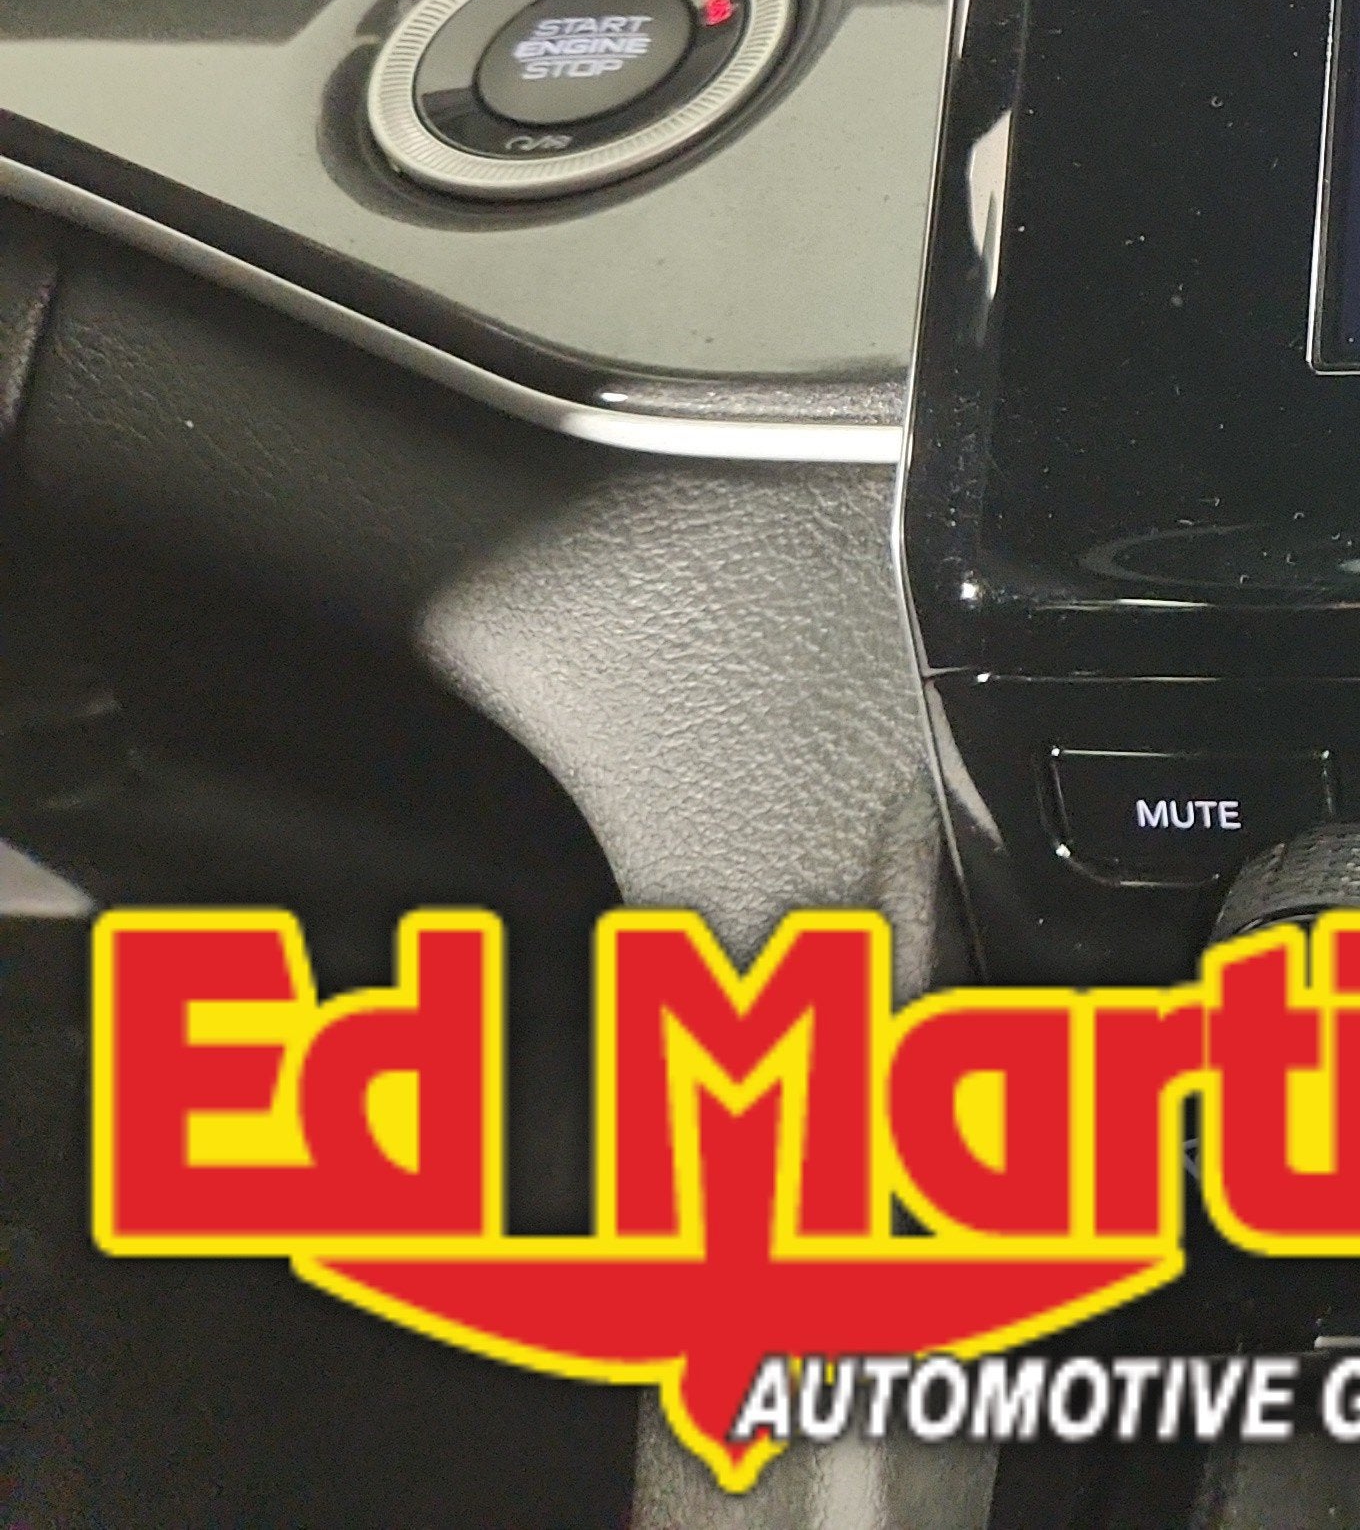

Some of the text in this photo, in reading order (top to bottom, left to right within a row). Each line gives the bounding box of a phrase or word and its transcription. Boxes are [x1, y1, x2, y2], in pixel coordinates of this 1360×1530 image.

[534, 15, 653, 36] START
[512, 37, 652, 58] ENGINE
[522, 59, 624, 79] STOP
[1136, 799, 1241, 829] MUTE
